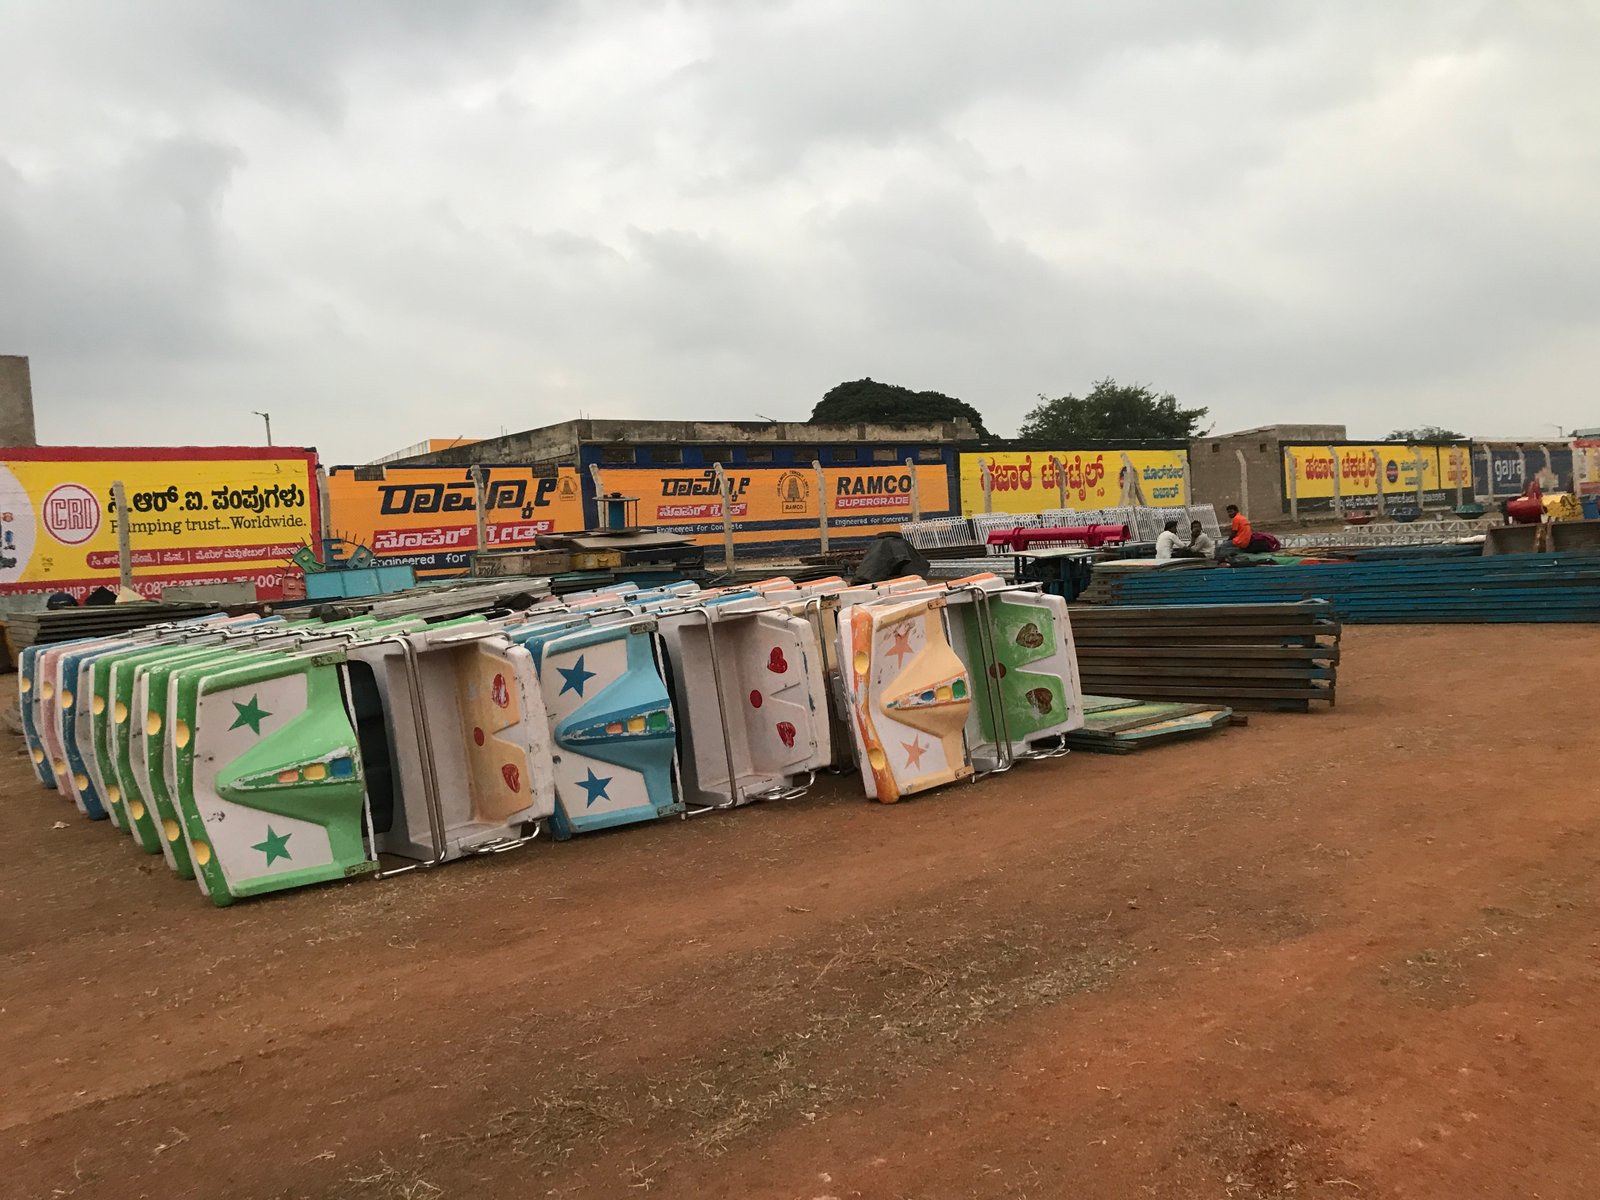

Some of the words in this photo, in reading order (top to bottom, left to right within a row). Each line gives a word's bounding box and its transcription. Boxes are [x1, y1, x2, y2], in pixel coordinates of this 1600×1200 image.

[837, 475, 912, 495] RAMCO
[211, 483, 305, 513] ಪಂಪುಗಳು
[838, 497, 909, 507] SUPERGRADE
[50, 498, 92, 531] CRI
[835, 518, 867, 527] Engineered
[109, 518, 182, 535] Pmping
[446, 552, 467, 564] for
